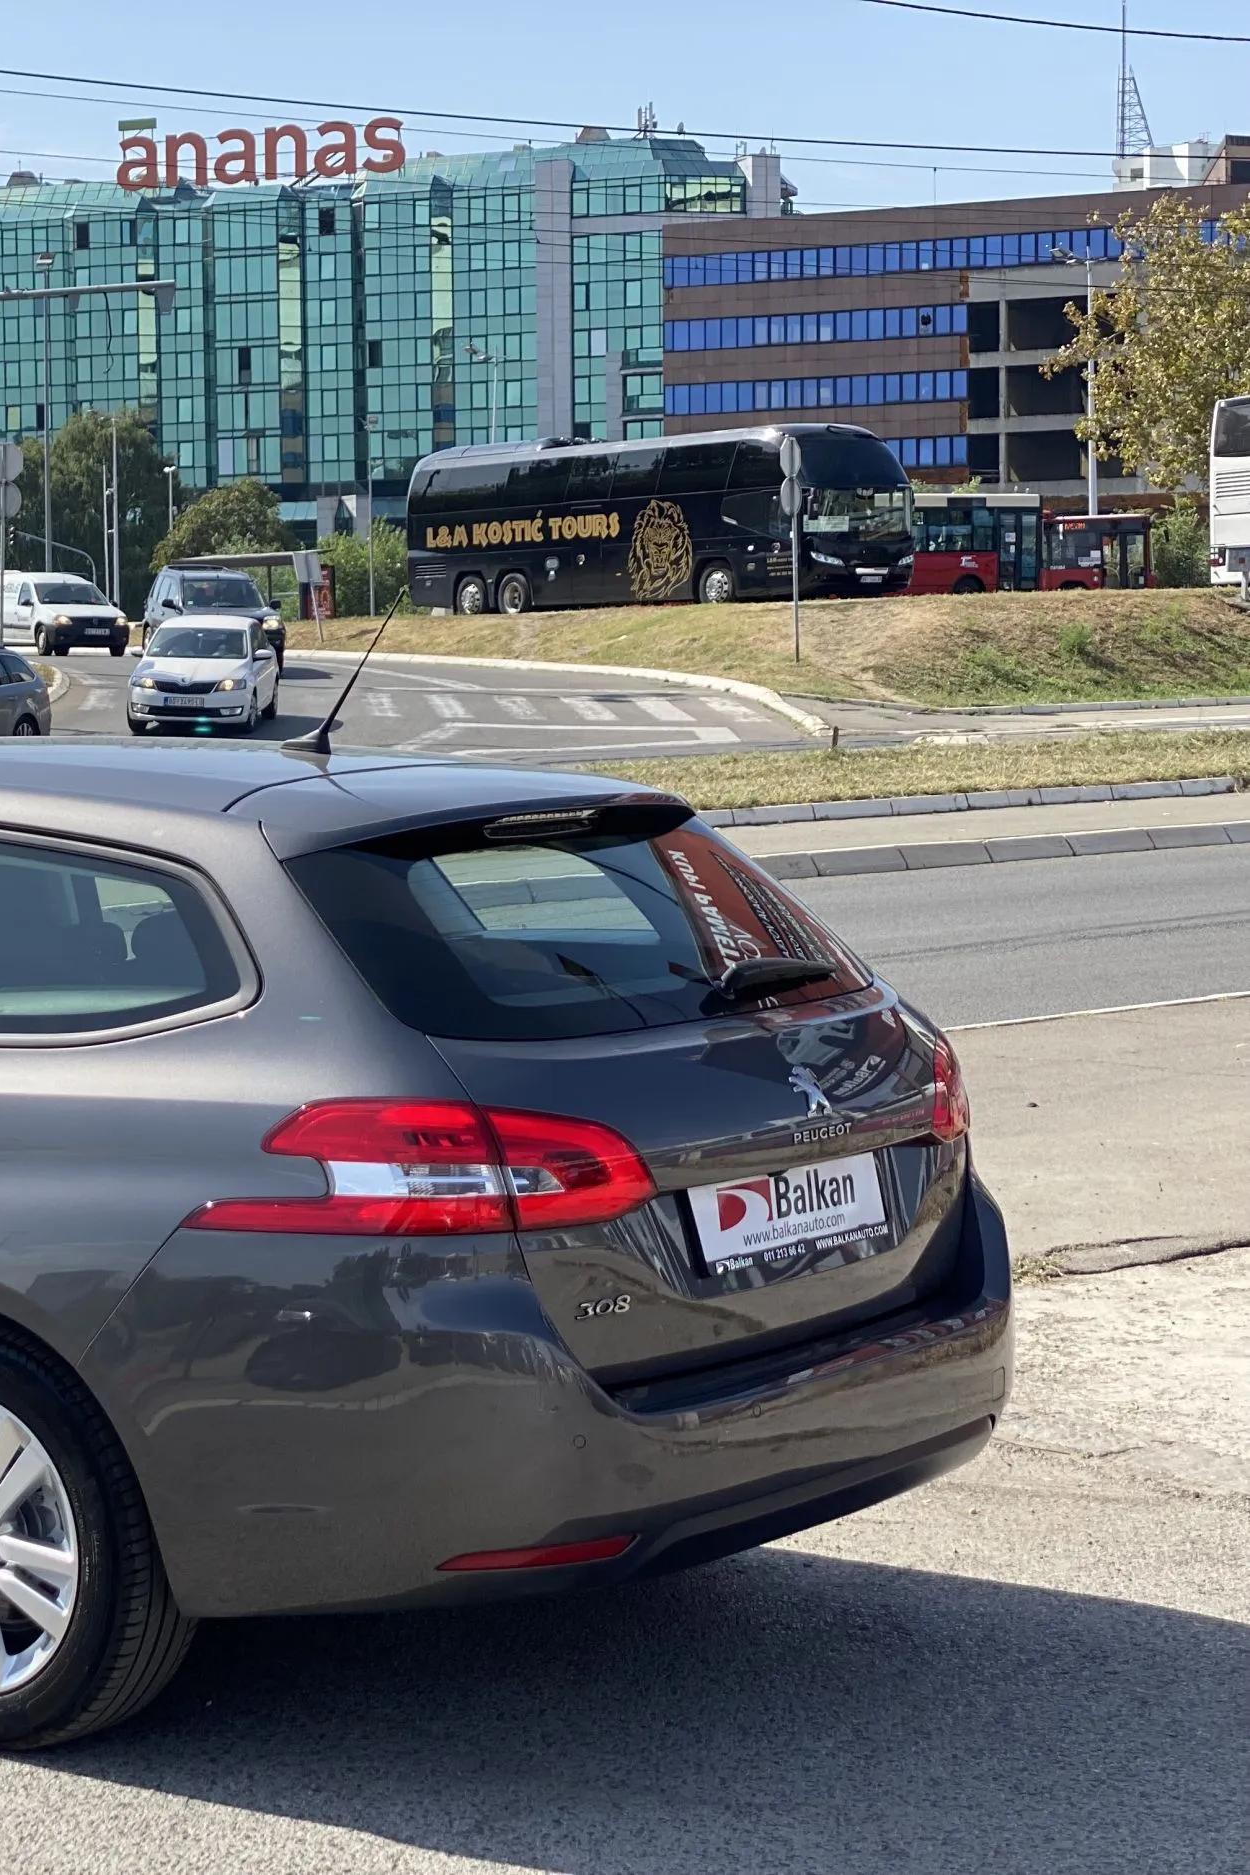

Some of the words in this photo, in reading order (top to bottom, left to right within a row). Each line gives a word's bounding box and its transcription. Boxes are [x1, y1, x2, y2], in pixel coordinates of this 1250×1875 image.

[426, 525, 469, 549] L&M
[472, 510, 544, 547] KOSTIĆ
[548, 511, 620, 540] TOURS
[793, 1122, 852, 1144] PEUGEOT
[773, 1168, 856, 1219] Balkan
[729, 1256, 753, 1270] Balkan
[763, 1250, 775, 1262] 011
[776, 1247, 788, 1259] 213
[797, 1243, 806, 1254] 42
[814, 1224, 889, 1250] WWW.BALKANAUTO.COM
[742, 1213, 846, 1247] www.balkanauto.com
[574, 1294, 631, 1320] 308
